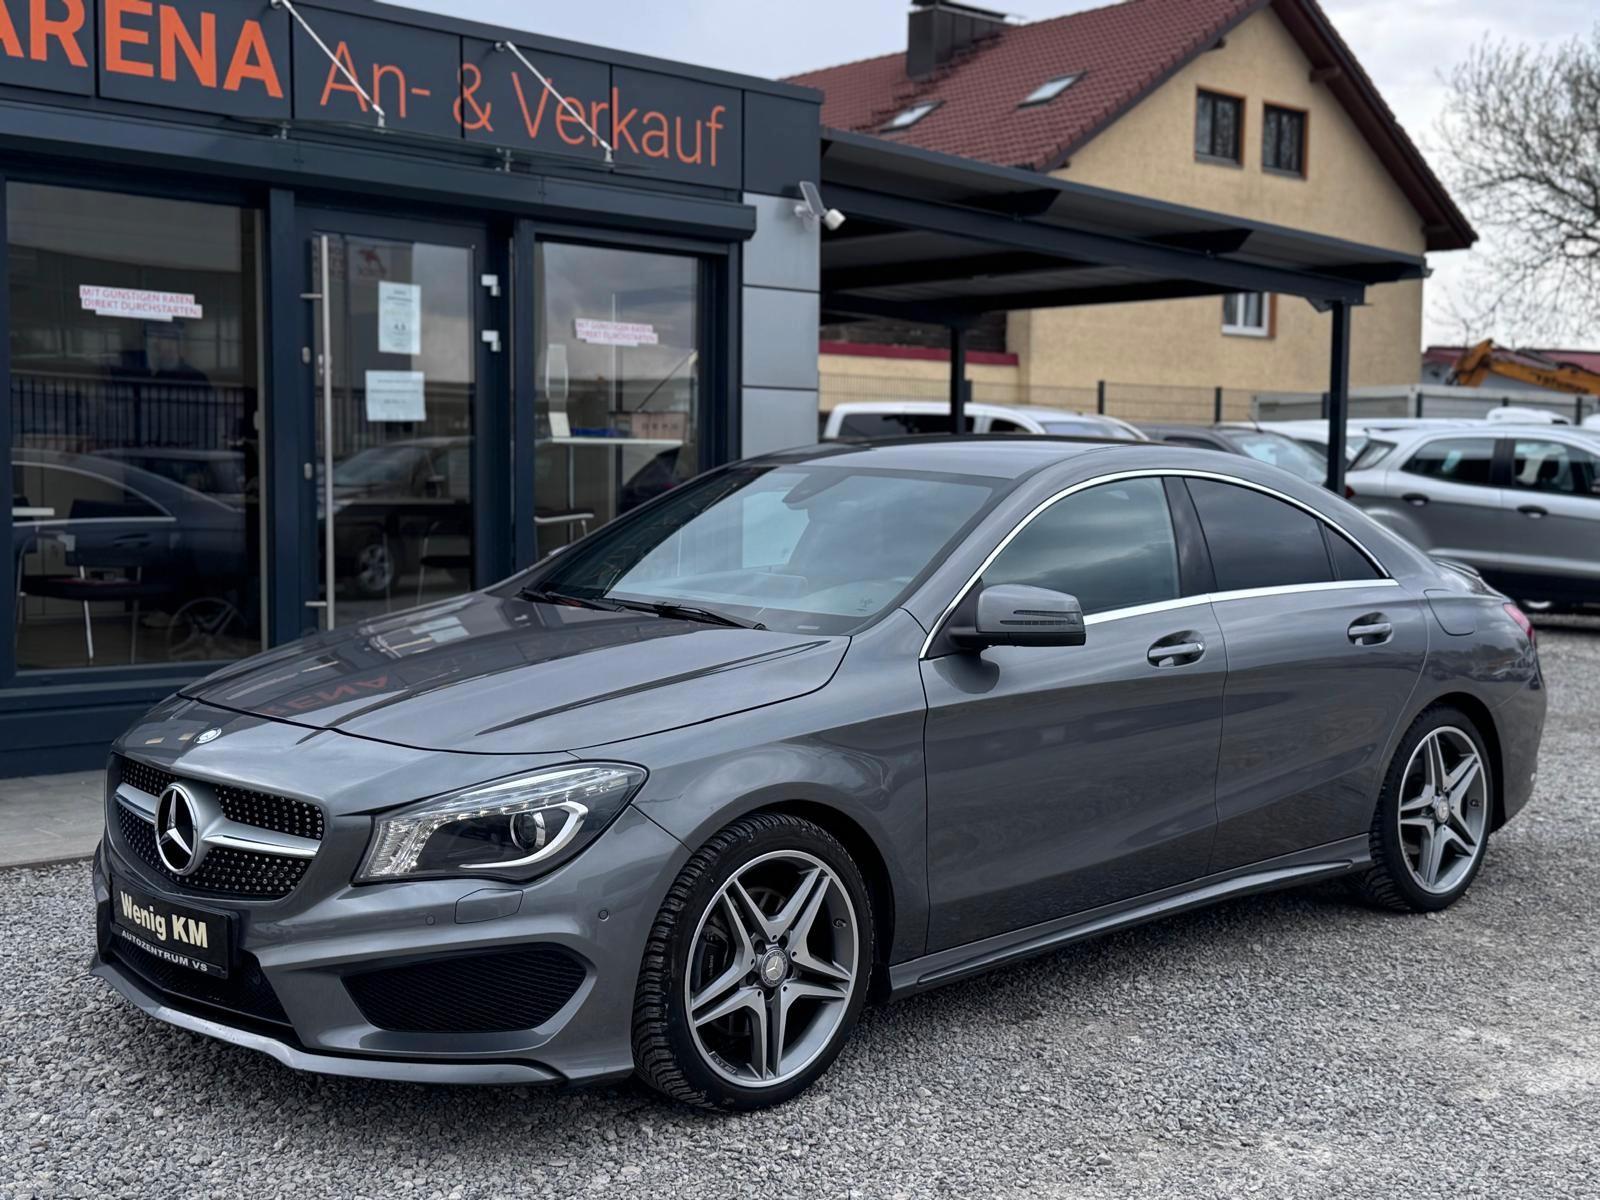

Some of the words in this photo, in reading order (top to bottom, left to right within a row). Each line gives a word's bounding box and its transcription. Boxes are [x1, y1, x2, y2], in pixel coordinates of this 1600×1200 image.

[320, 41, 431, 118] An-
[453, 63, 494, 132] &
[511, 72, 726, 167] Verkauf
[120, 890, 168, 942] Wenig
[171, 914, 208, 949] KM
[121, 930, 189, 967] AUTOZENTRUM
[191, 960, 208, 972] VS
